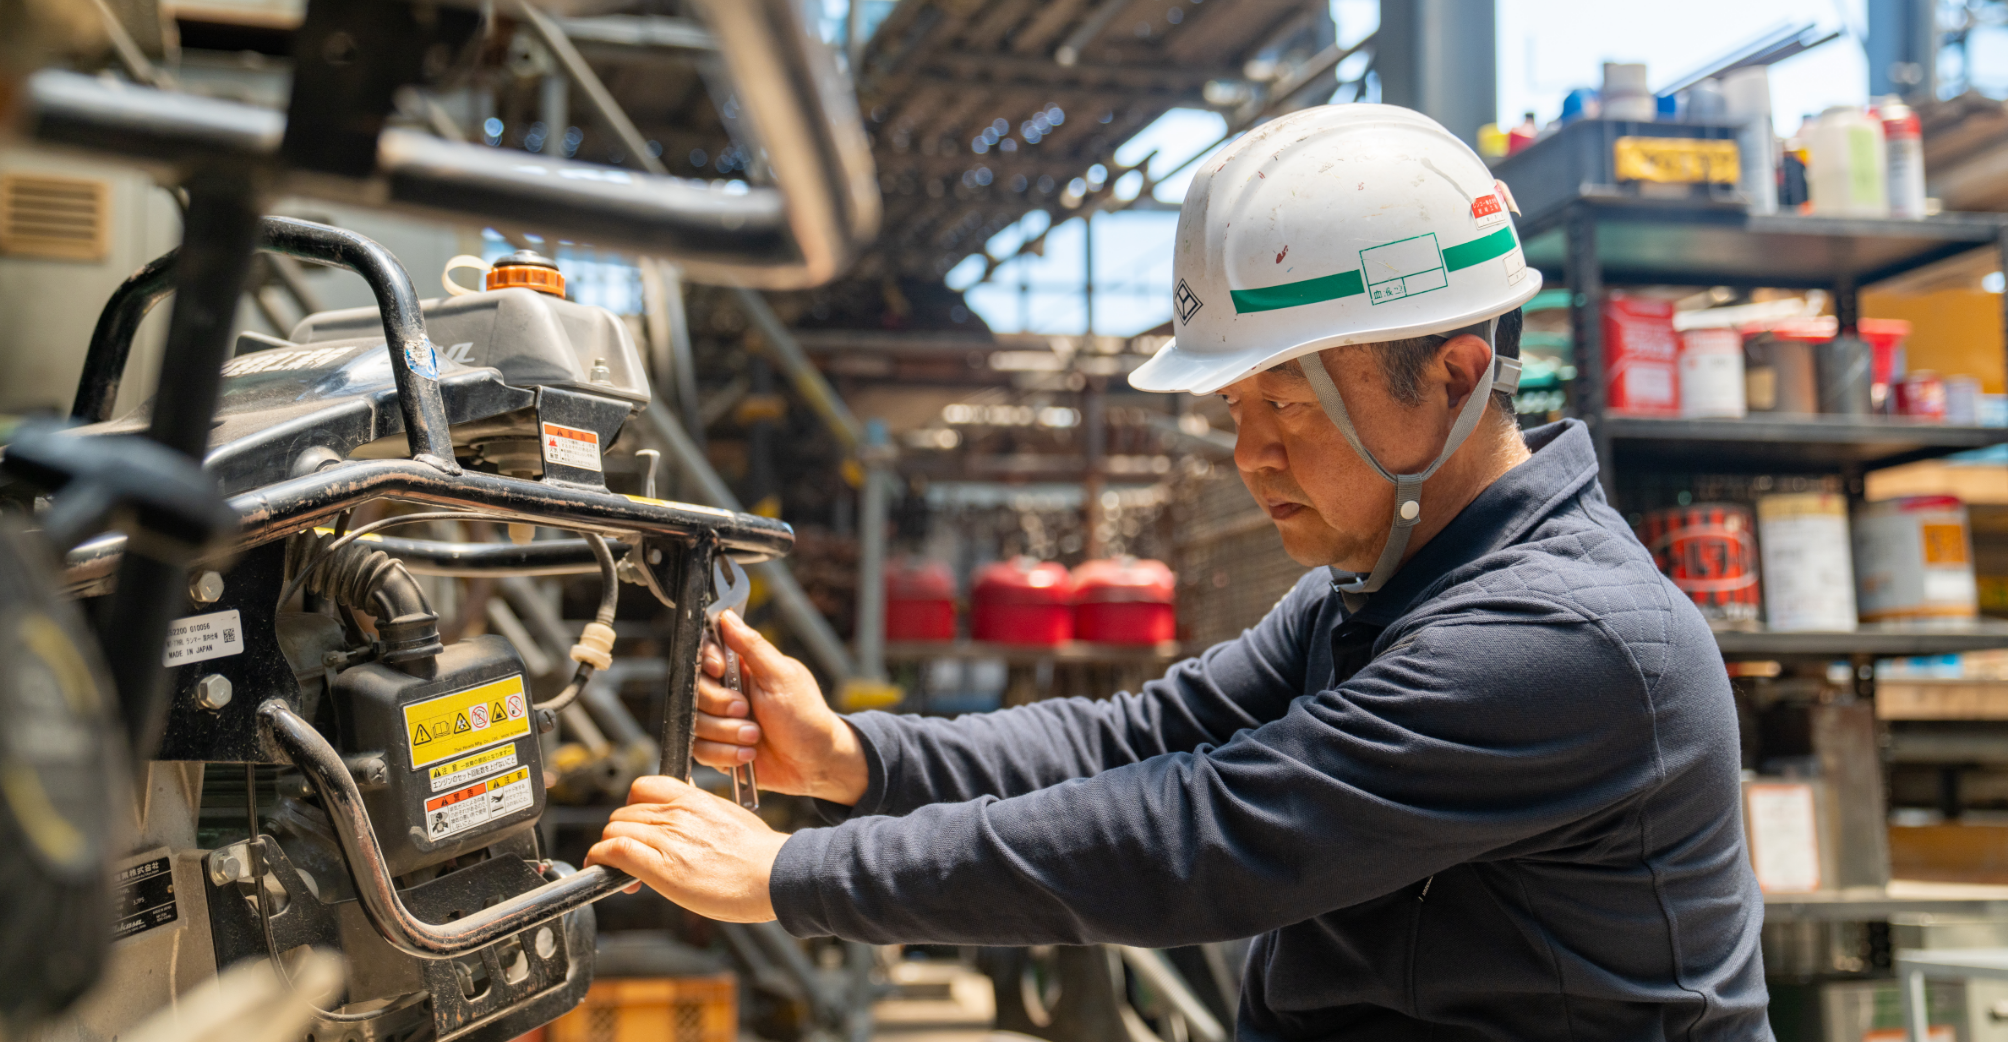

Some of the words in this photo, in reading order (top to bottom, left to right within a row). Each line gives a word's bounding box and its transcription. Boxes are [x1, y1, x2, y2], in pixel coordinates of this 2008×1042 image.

[168, 649, 183, 659] MADE
[186, 648, 194, 656] IN
[196, 644, 213, 654] JAPAN
